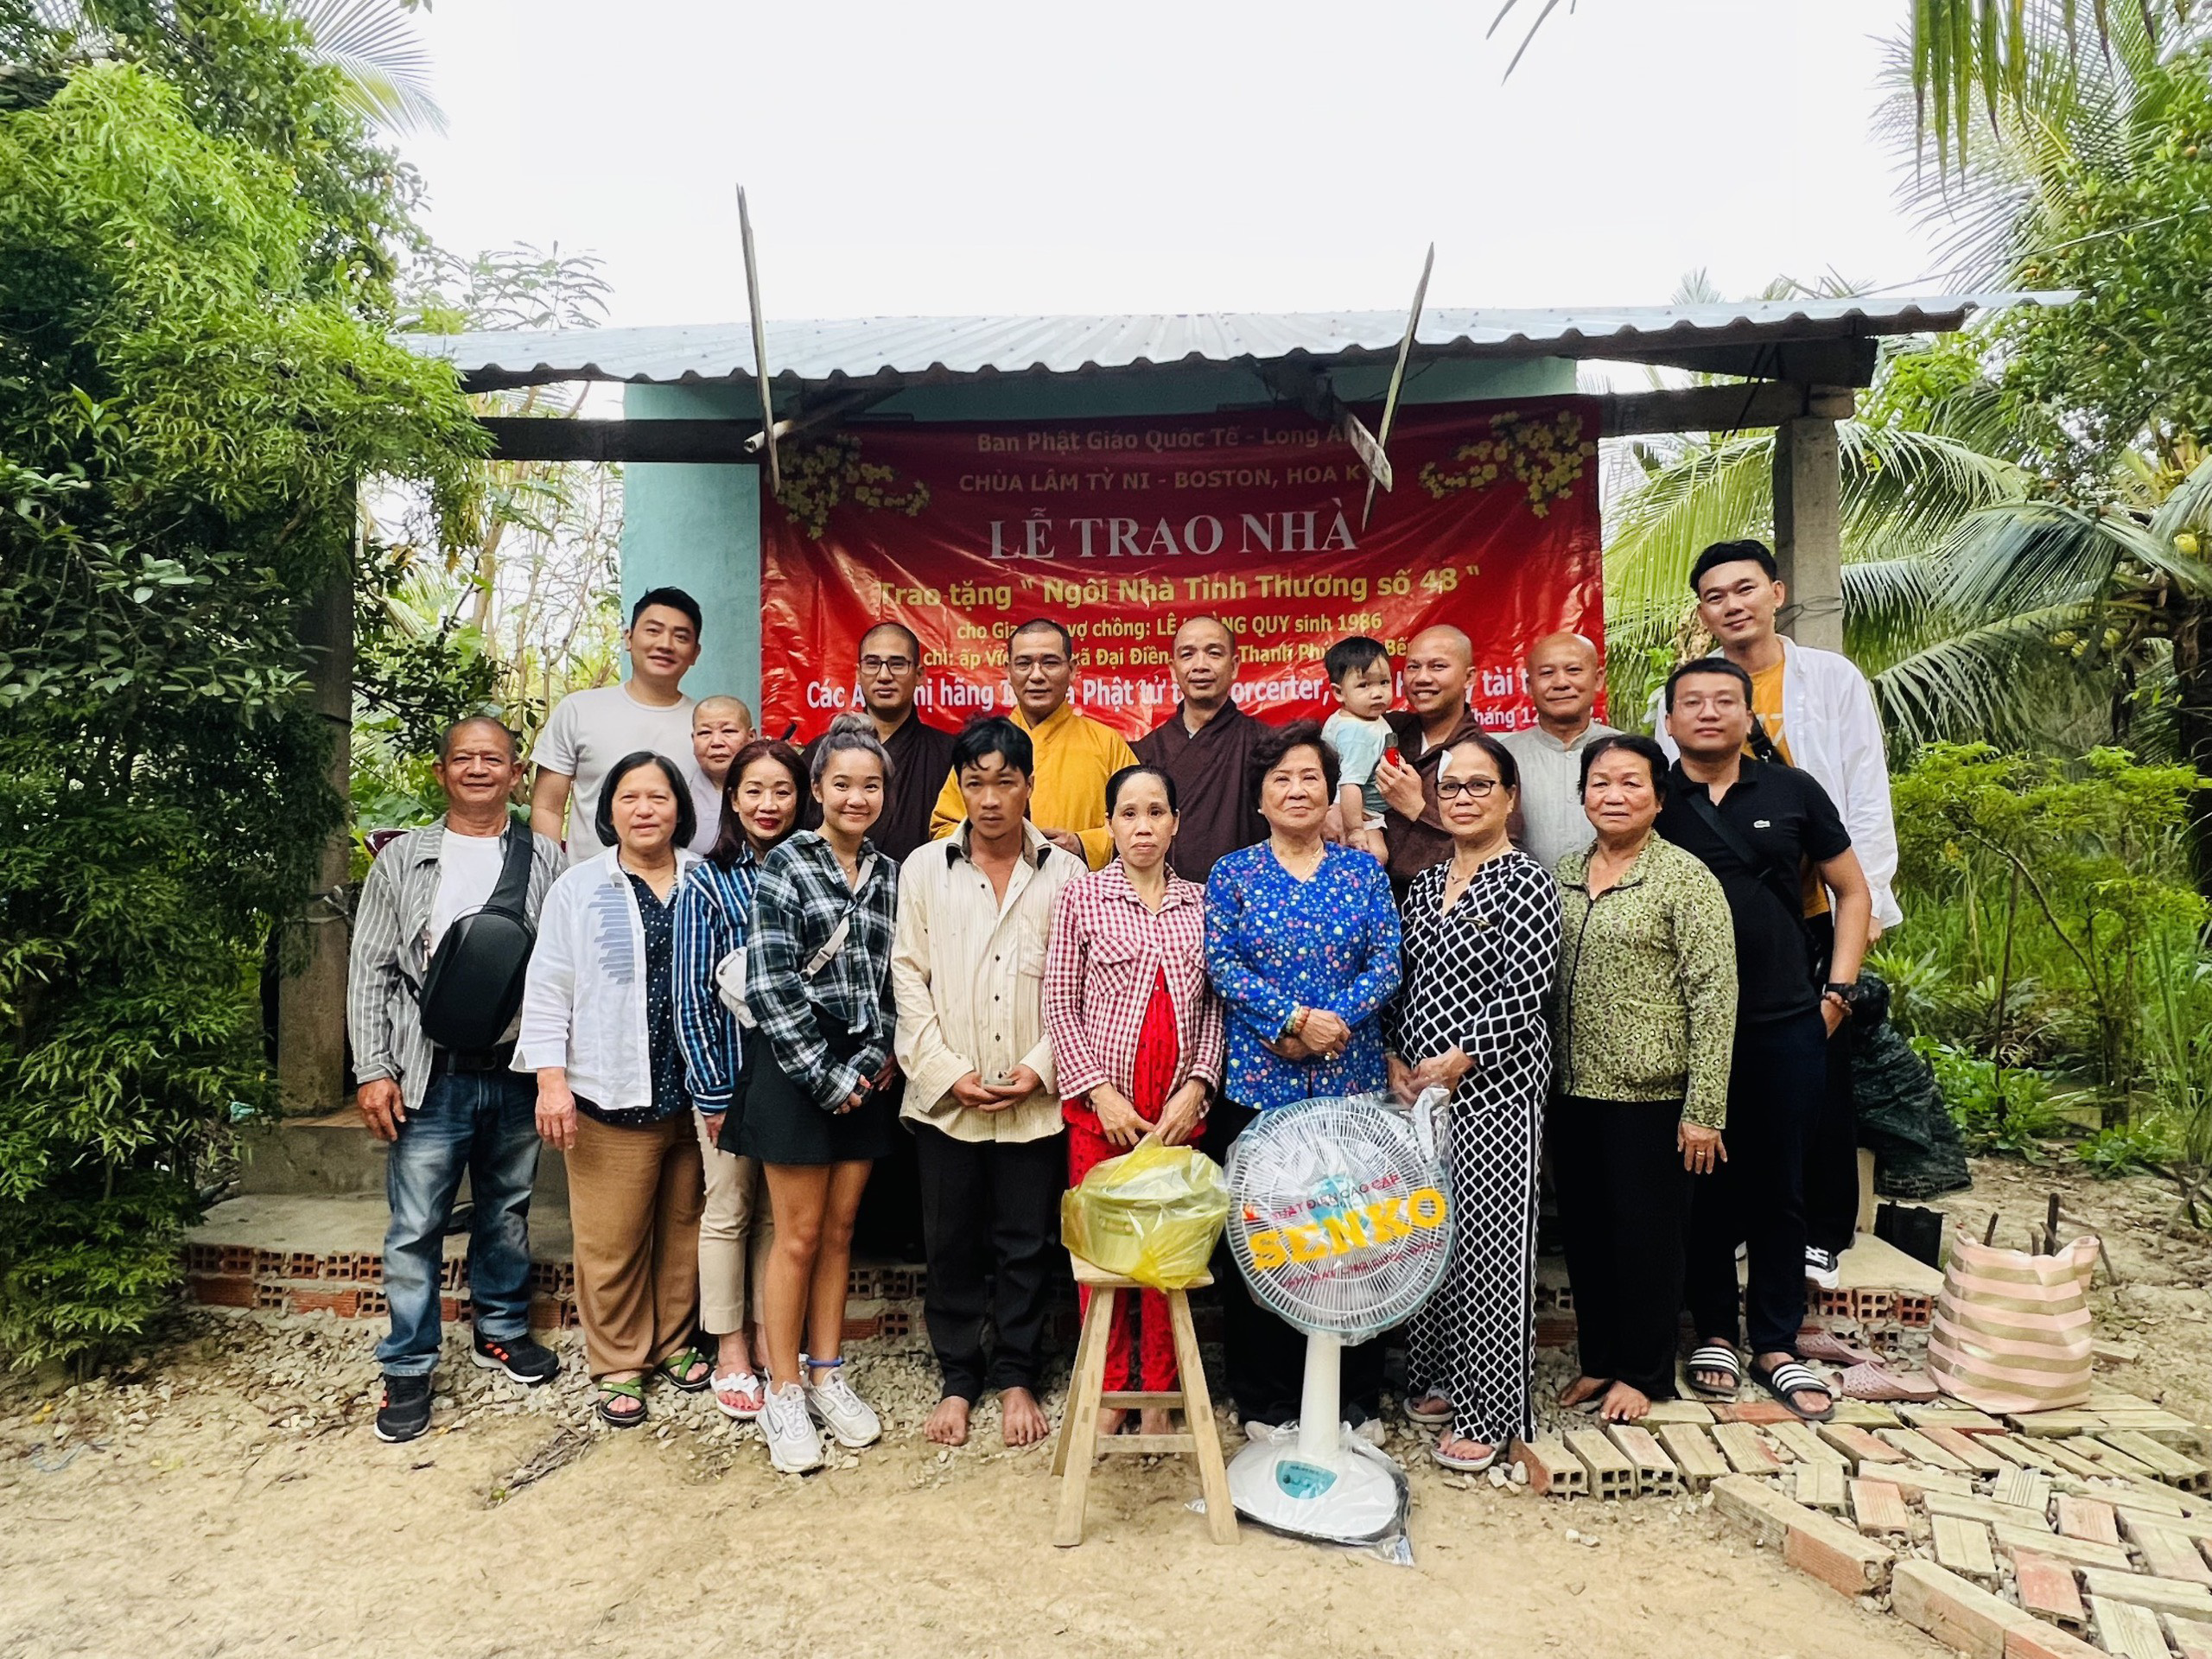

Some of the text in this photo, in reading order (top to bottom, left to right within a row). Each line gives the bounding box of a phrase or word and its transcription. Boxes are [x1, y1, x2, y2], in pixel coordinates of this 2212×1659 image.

[977, 433, 1020, 452] Ban
[1027, 429, 1079, 455] Phật
[1086, 428, 1138, 451] Giáo
[1211, 424, 1241, 447] Tế
[1263, 427, 1319, 448] Long
[958, 468, 1023, 492] CHÙA
[1031, 467, 1078, 492] LÂM
[1123, 472, 1151, 490] NI
[1174, 468, 1279, 489] BOSTON,
[1287, 467, 1338, 486] HOA
[988, 497, 1360, 560] LỄ TRAO NHÀ
[880, 582, 942, 606] Trao
[950, 580, 1012, 612] tặng
[1043, 577, 1109, 609] Ngôi
[1118, 576, 1175, 603] Nhà
[1182, 575, 1247, 601] Tình
[1255, 573, 1368, 603] Thương
[1376, 568, 1414, 596] số
[1419, 567, 1459, 593] 48
[956, 621, 988, 639] cho
[1066, 620, 1089, 642] vợ
[1156, 612, 1178, 636] LÊ
[1252, 614, 1291, 638] QUY
[1294, 613, 1332, 633] sinh
[1338, 611, 1382, 632] 1986
[1095, 646, 1124, 670] Đại
[806, 677, 846, 709] Các
[940, 677, 994, 712] hãng
[1082, 676, 1135, 713] Phật
[1230, 674, 1330, 707] orcerter,
[1482, 665, 1514, 697] tài
[1248, 1186, 1446, 1272] SENKO
